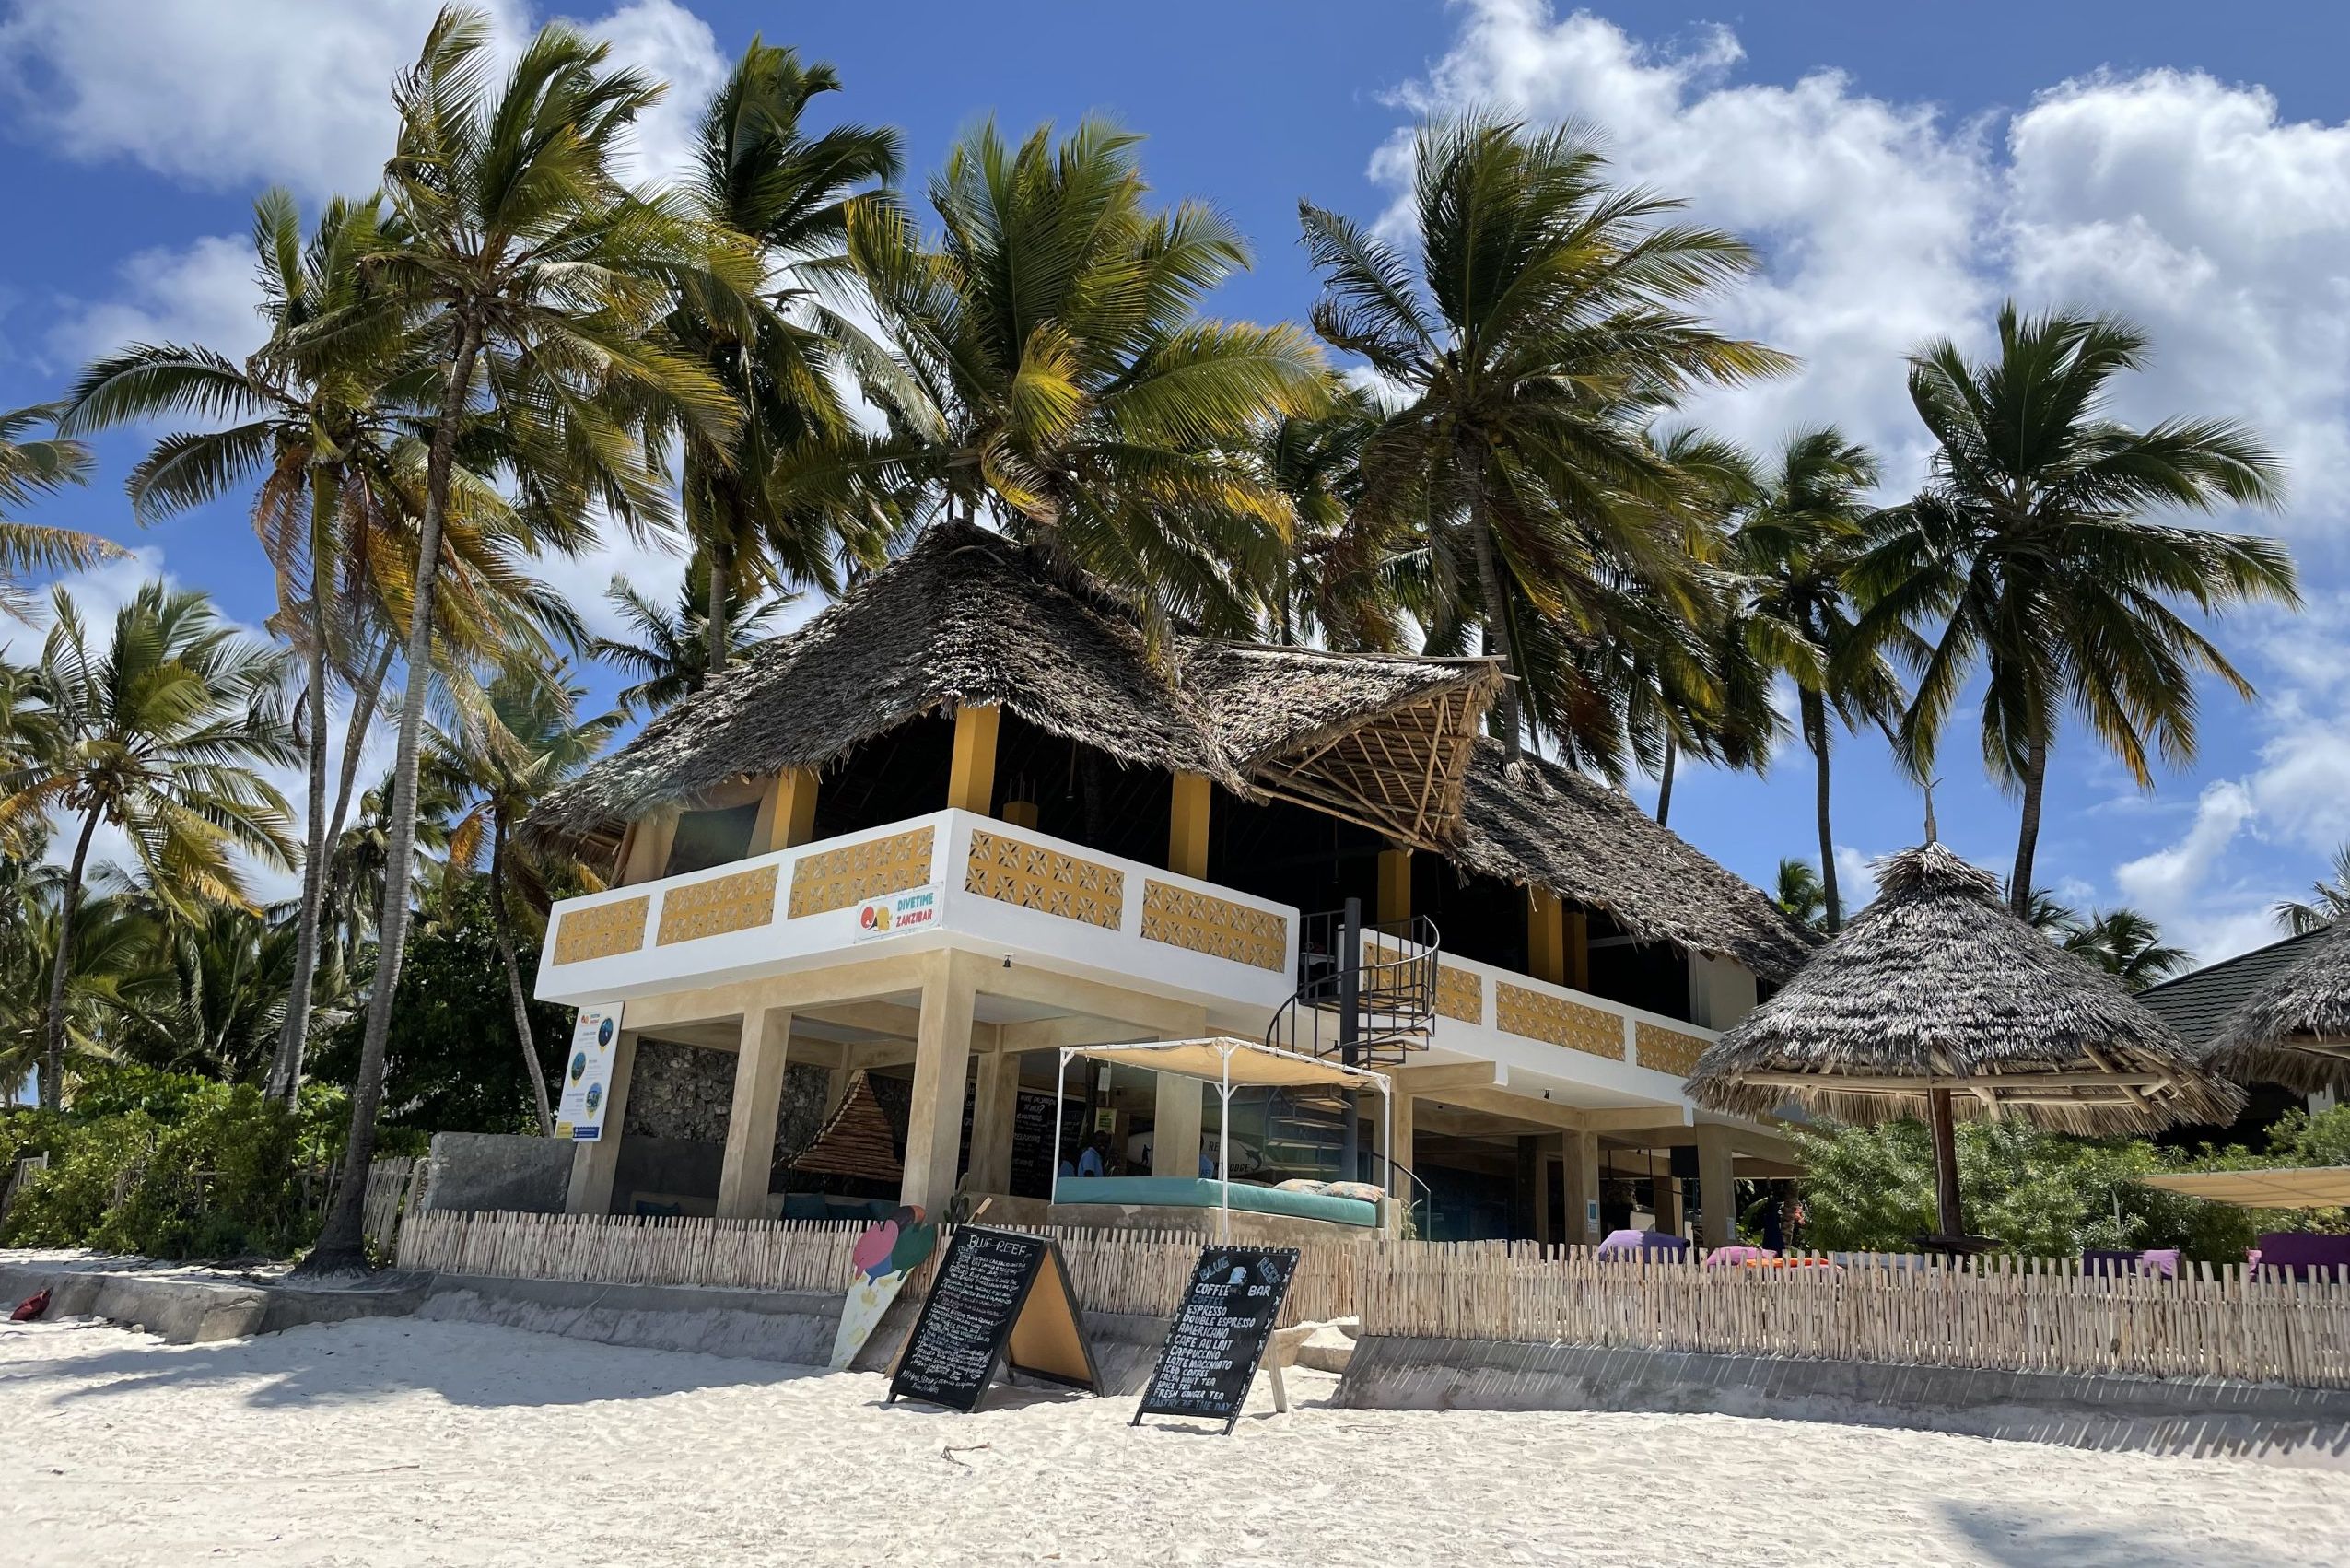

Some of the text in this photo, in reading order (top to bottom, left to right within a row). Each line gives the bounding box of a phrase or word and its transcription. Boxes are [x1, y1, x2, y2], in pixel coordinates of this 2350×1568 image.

[897, 893, 934, 911] DIVETIME
[896, 909, 932, 928] ZANZIBAR
[1230, 1164, 1250, 1172] ODGE
[967, 1235, 1026, 1255] BLUE REEF
[1198, 1255, 1281, 1284] BLUE REEF
[1195, 1283, 1271, 1297] COFFEE BAR
[1191, 1294, 1225, 1305] COFFEE
[1186, 1304, 1228, 1316] ESPRESSO
[1182, 1314, 1256, 1328] DOUBLE ESPRESSO
[1177, 1323, 1230, 1340] AMERICANO
[1174, 1334, 1234, 1351] CAFE AU LAIT
[1169, 1345, 1222, 1360] CAPPUCCINO
[1166, 1355, 1188, 1368] LATTE
[1163, 1364, 1210, 1377] ICED COFFEE
[1157, 1381, 1175, 1389] SPICE
[1160, 1373, 1179, 1383] FRESH
[1201, 1377, 1216, 1387] TEA
[1153, 1388, 1224, 1400] FRESH GINGER TEA
[1149, 1398, 1180, 1409] PASTRY
[1195, 1400, 1212, 1410] THE
[1214, 1401, 1233, 1412] DAY
